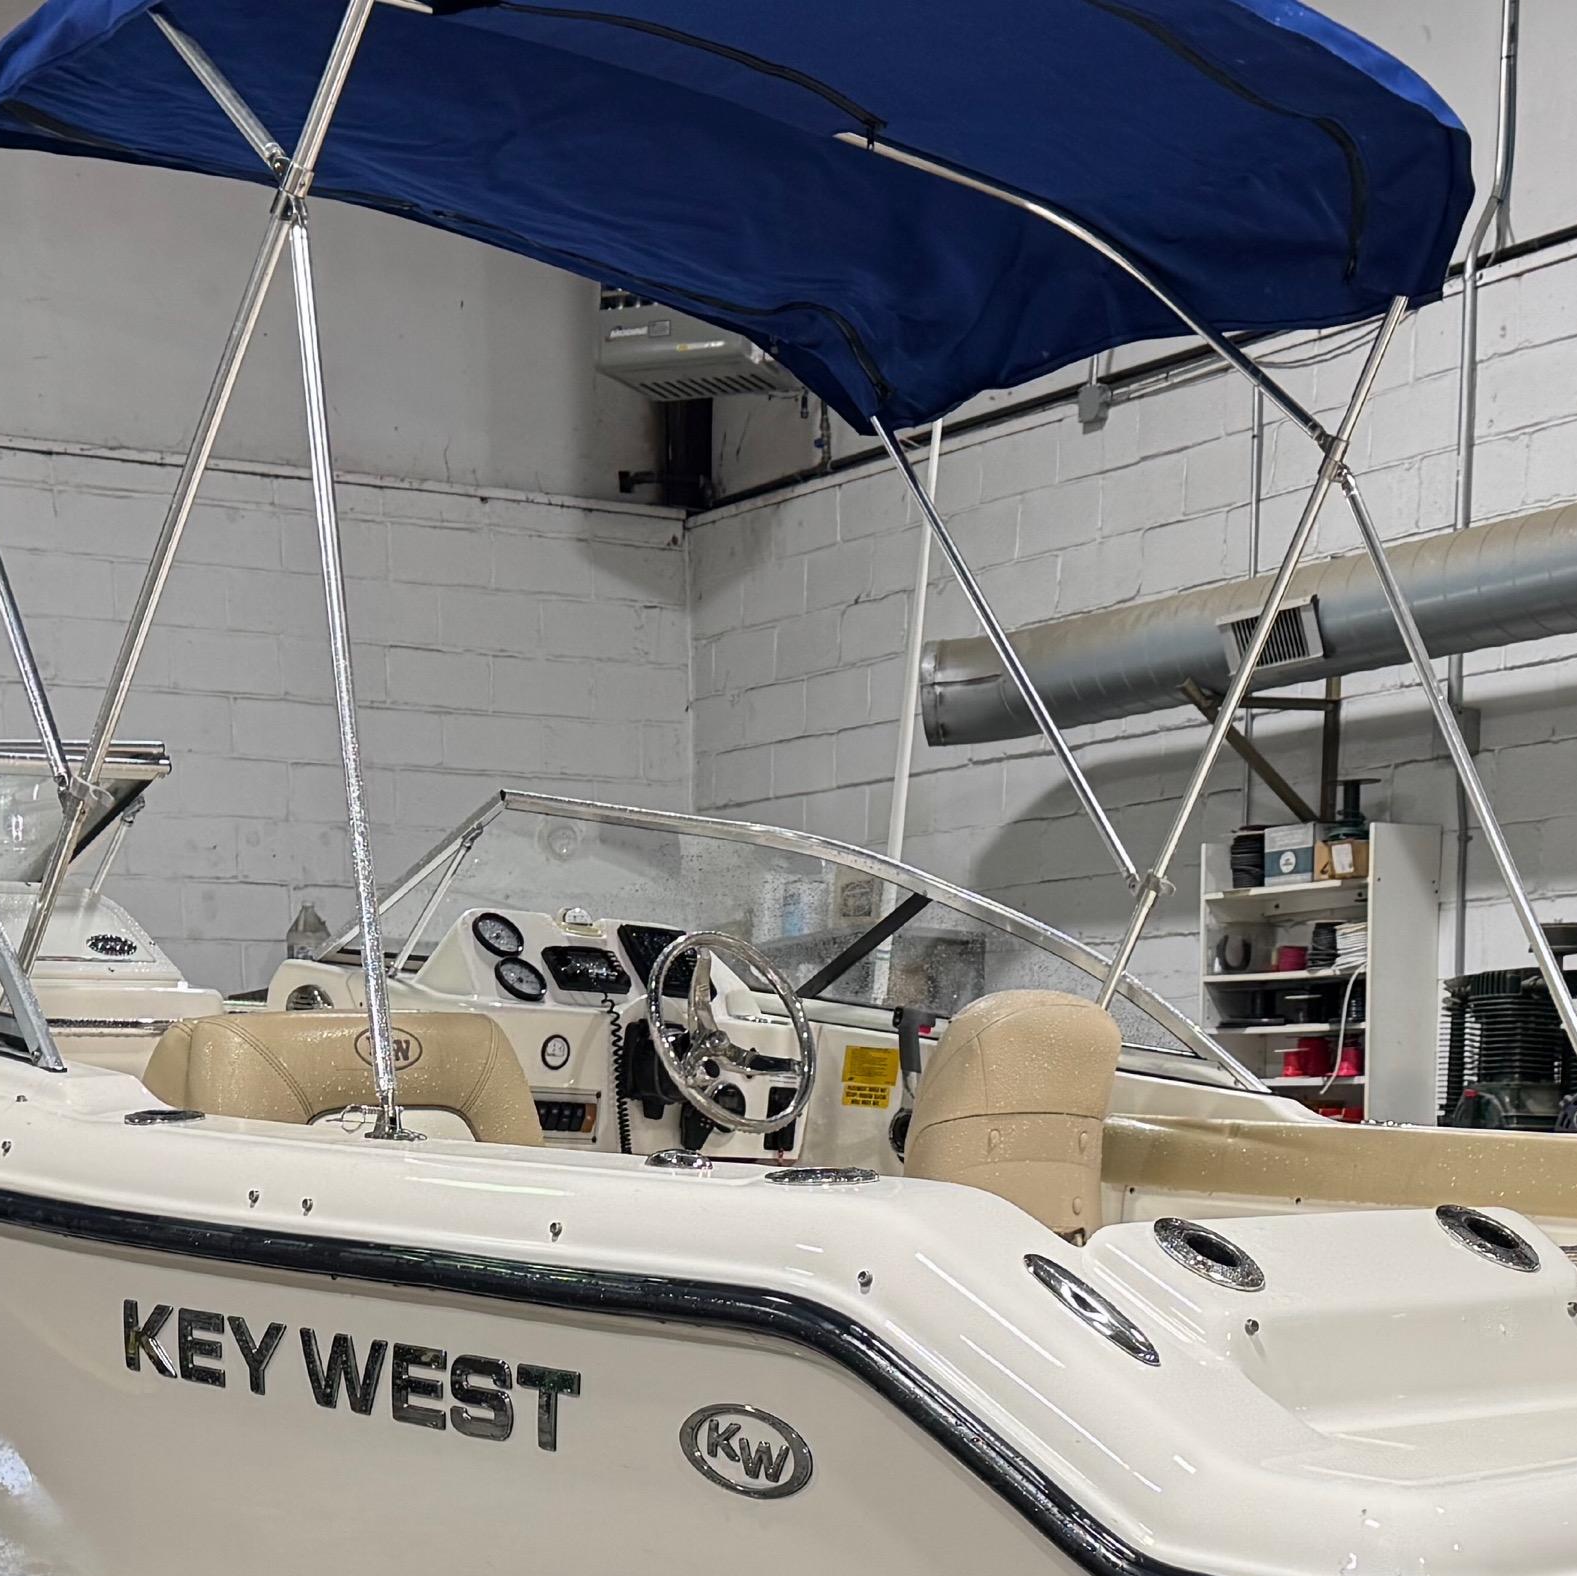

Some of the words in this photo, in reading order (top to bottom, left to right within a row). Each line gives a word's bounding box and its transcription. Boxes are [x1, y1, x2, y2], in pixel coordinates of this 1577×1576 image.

[123, 1298, 287, 1395] KEY
[300, 1326, 582, 1452] WEST
[706, 1418, 791, 1484] KW
